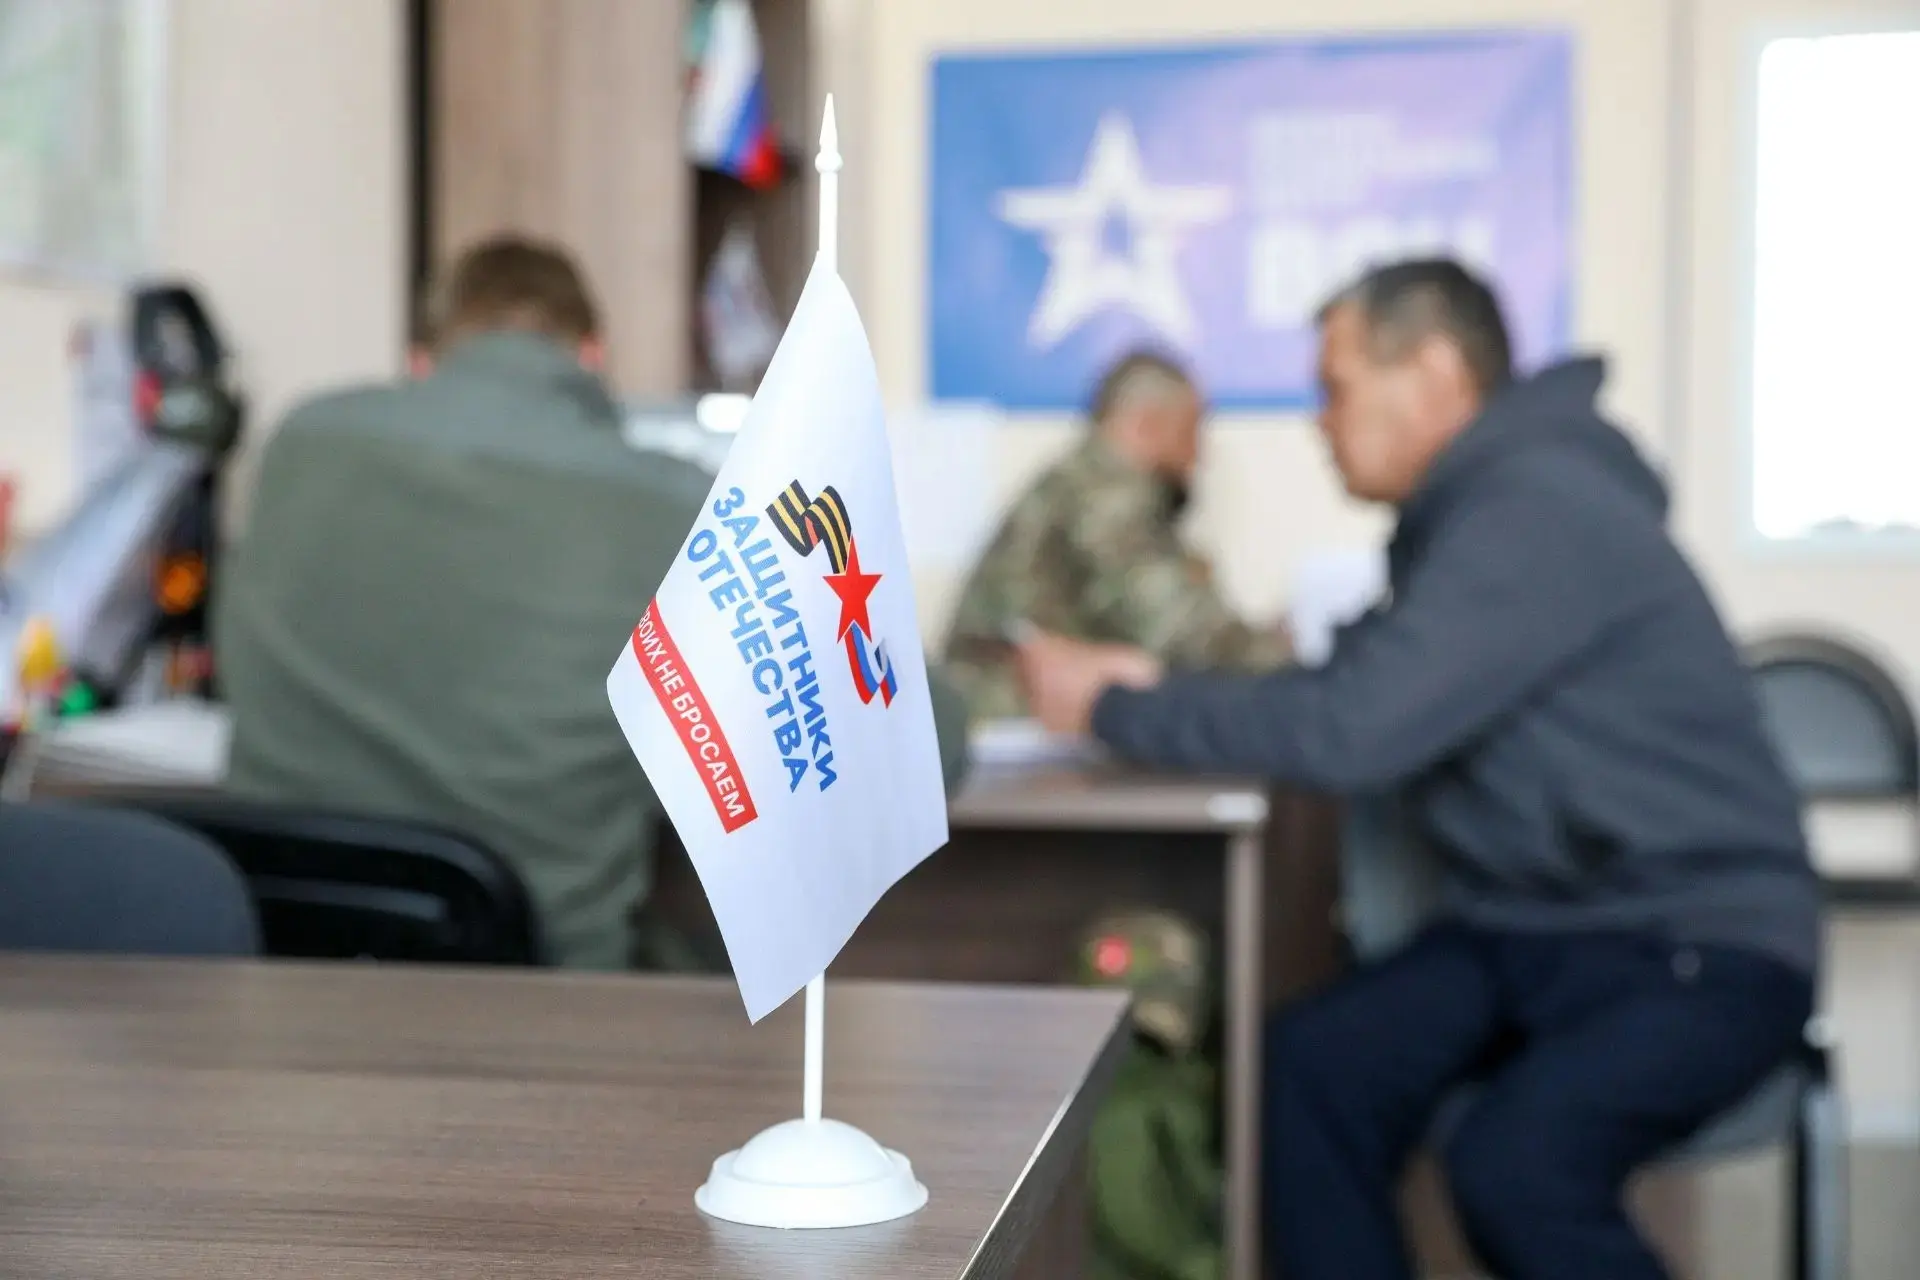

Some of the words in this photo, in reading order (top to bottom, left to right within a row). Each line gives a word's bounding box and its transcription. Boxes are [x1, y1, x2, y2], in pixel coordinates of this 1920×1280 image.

[638, 606, 667, 664] ВОИХ
[654, 659, 685, 695] НЕ
[671, 692, 746, 818] БРОСАЕМ
[687, 529, 808, 793] ОТЕЧЕСТВА
[713, 487, 837, 792] ЗАЩИТНИКИ
